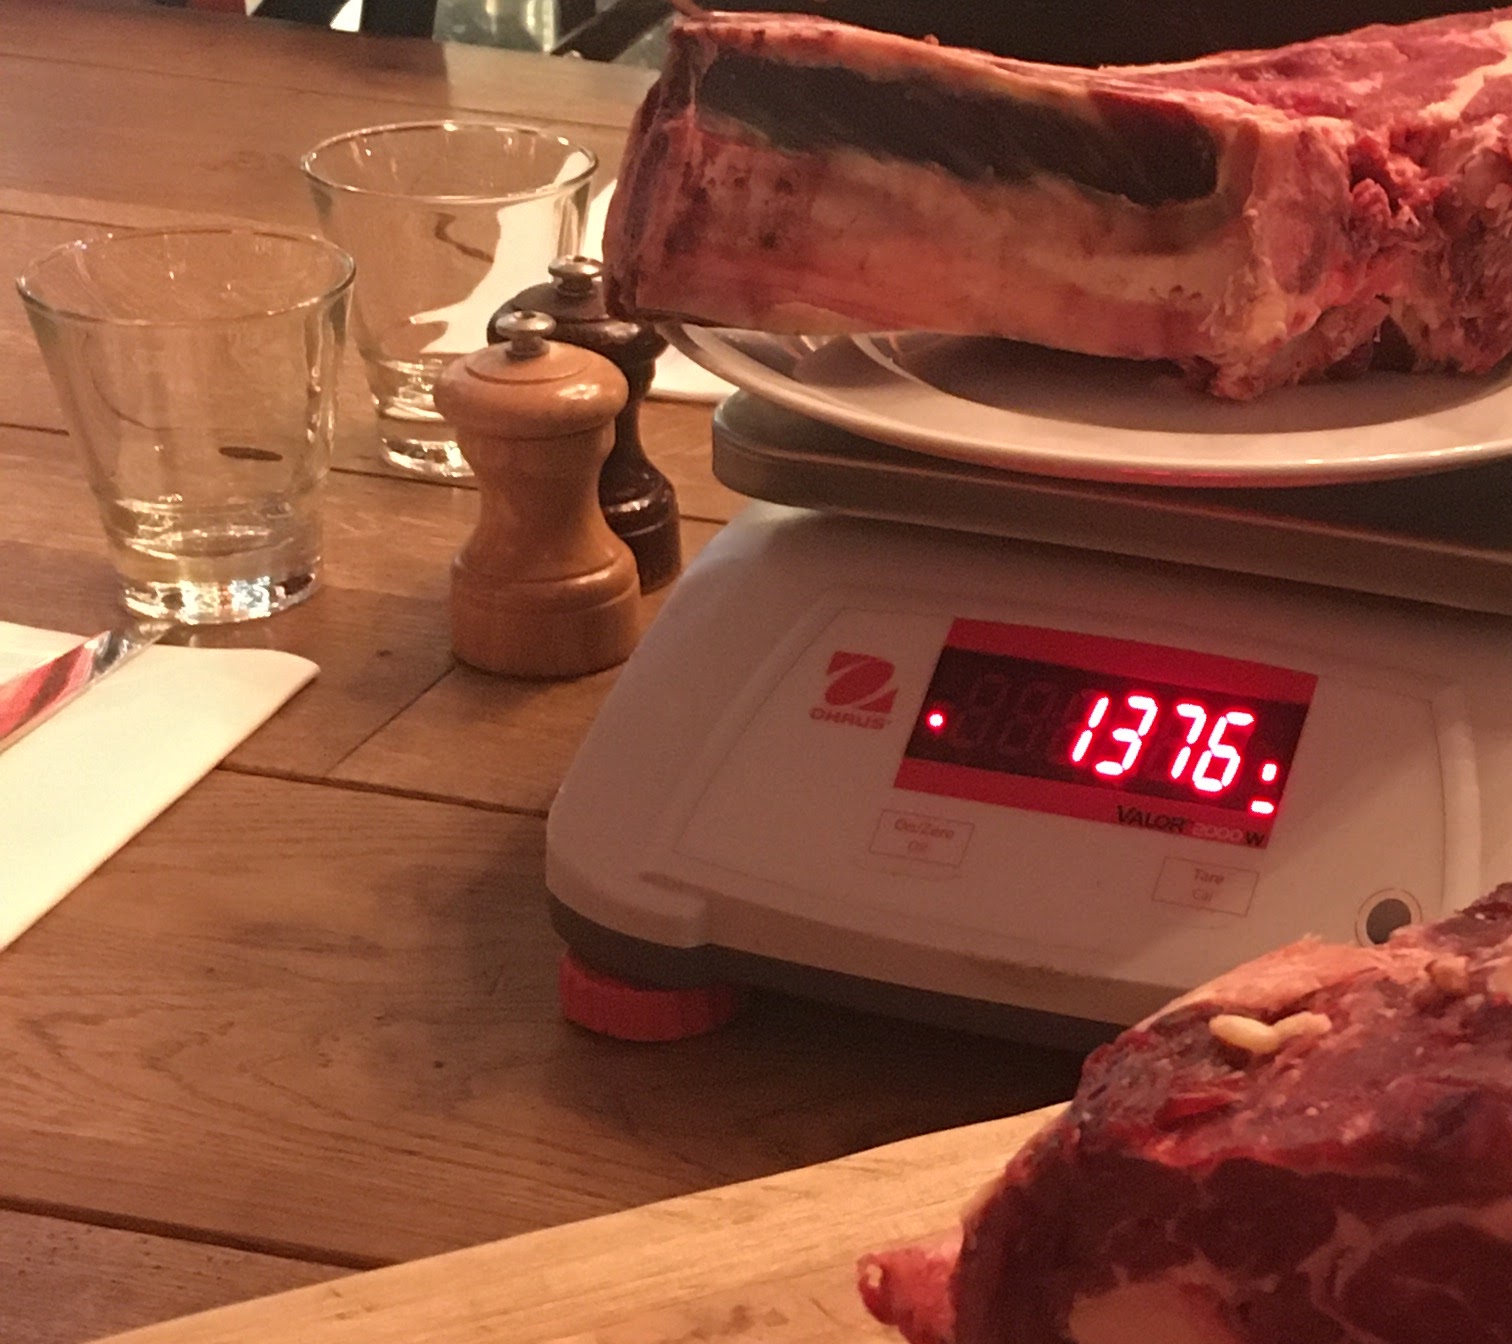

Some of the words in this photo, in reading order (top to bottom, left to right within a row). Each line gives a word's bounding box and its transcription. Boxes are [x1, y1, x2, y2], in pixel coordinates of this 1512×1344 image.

[1071, 694, 1255, 794] 1376
[1115, 804, 1187, 833] VALOR
[1193, 867, 1225, 886] Tare
